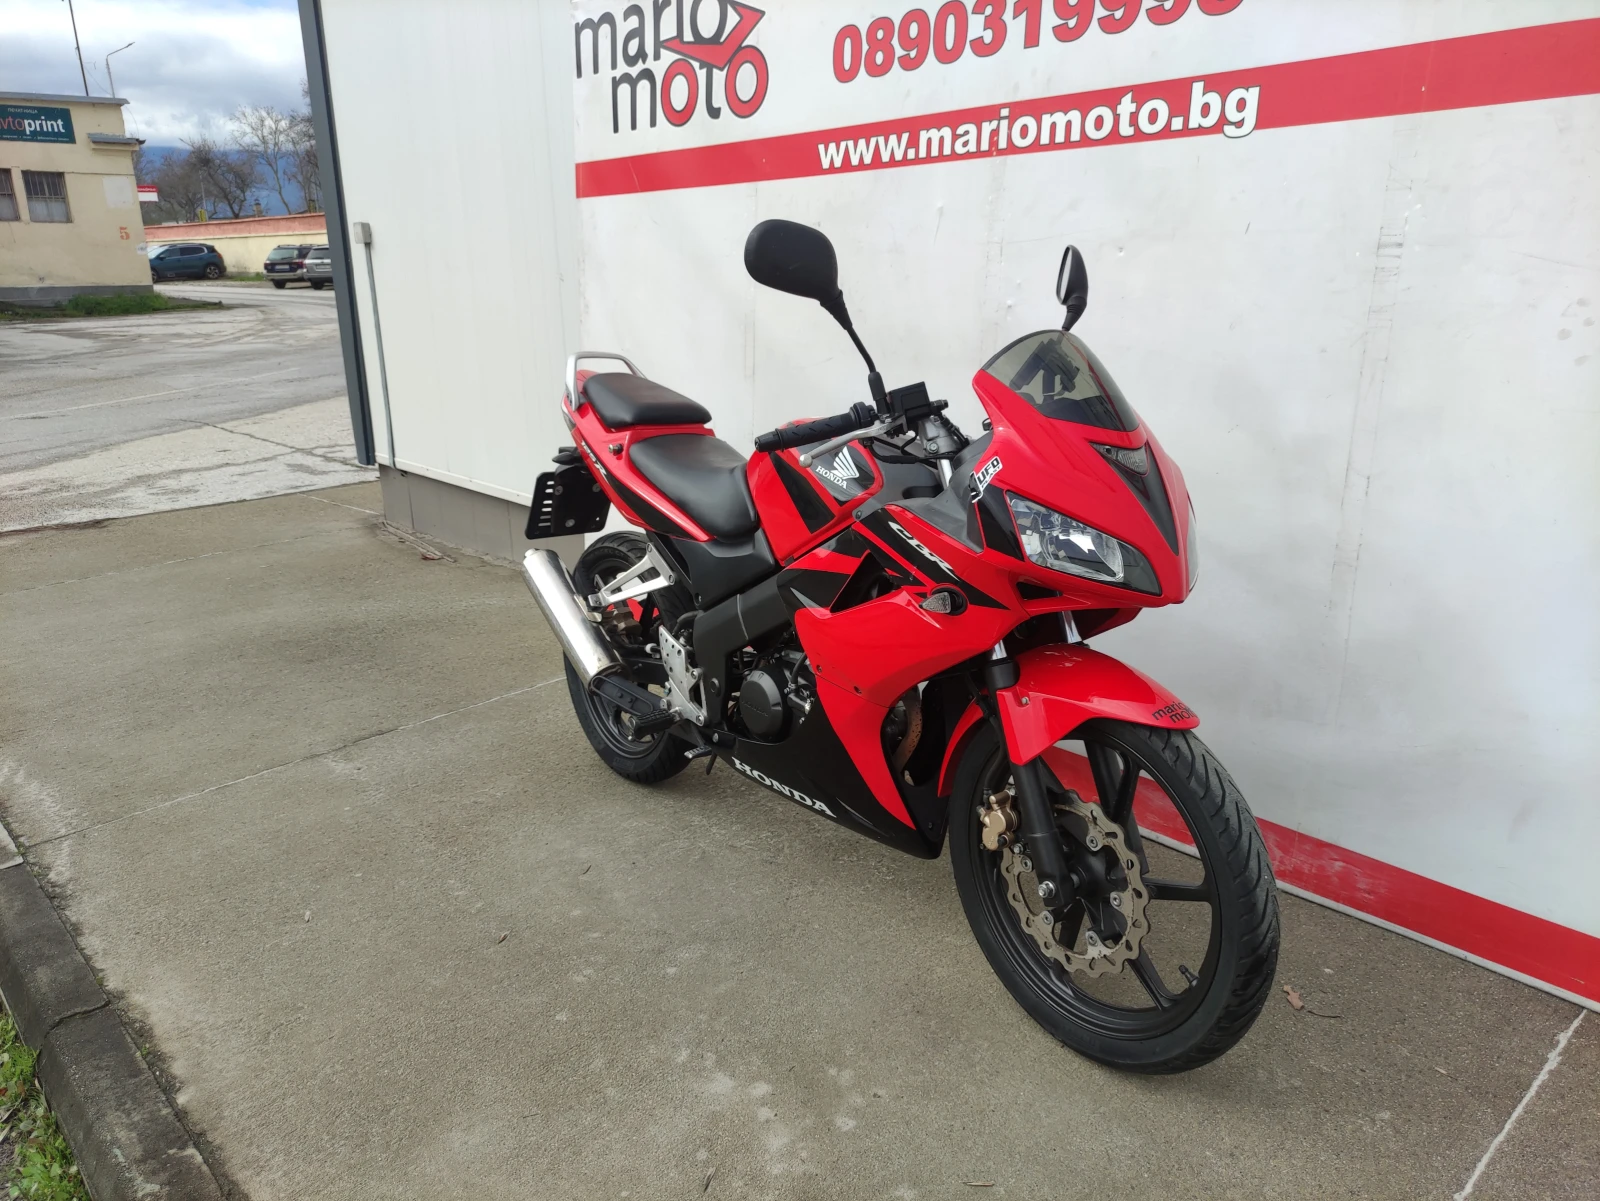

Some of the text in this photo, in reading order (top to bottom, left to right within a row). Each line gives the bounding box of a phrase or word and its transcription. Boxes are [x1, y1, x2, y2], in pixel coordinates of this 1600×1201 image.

[574, 0, 728, 78] mario
[832, 0, 1244, 83] 08903199
[612, 45, 769, 133] moto
[0, 115, 66, 135] vtoprint
[817, 81, 1261, 169] www.mariomoto.bg
[119, 226, 130, 240] 5
[815, 465, 848, 489] HONDA
[976, 456, 1000, 486] UFO
[731, 756, 837, 818] HONDA
